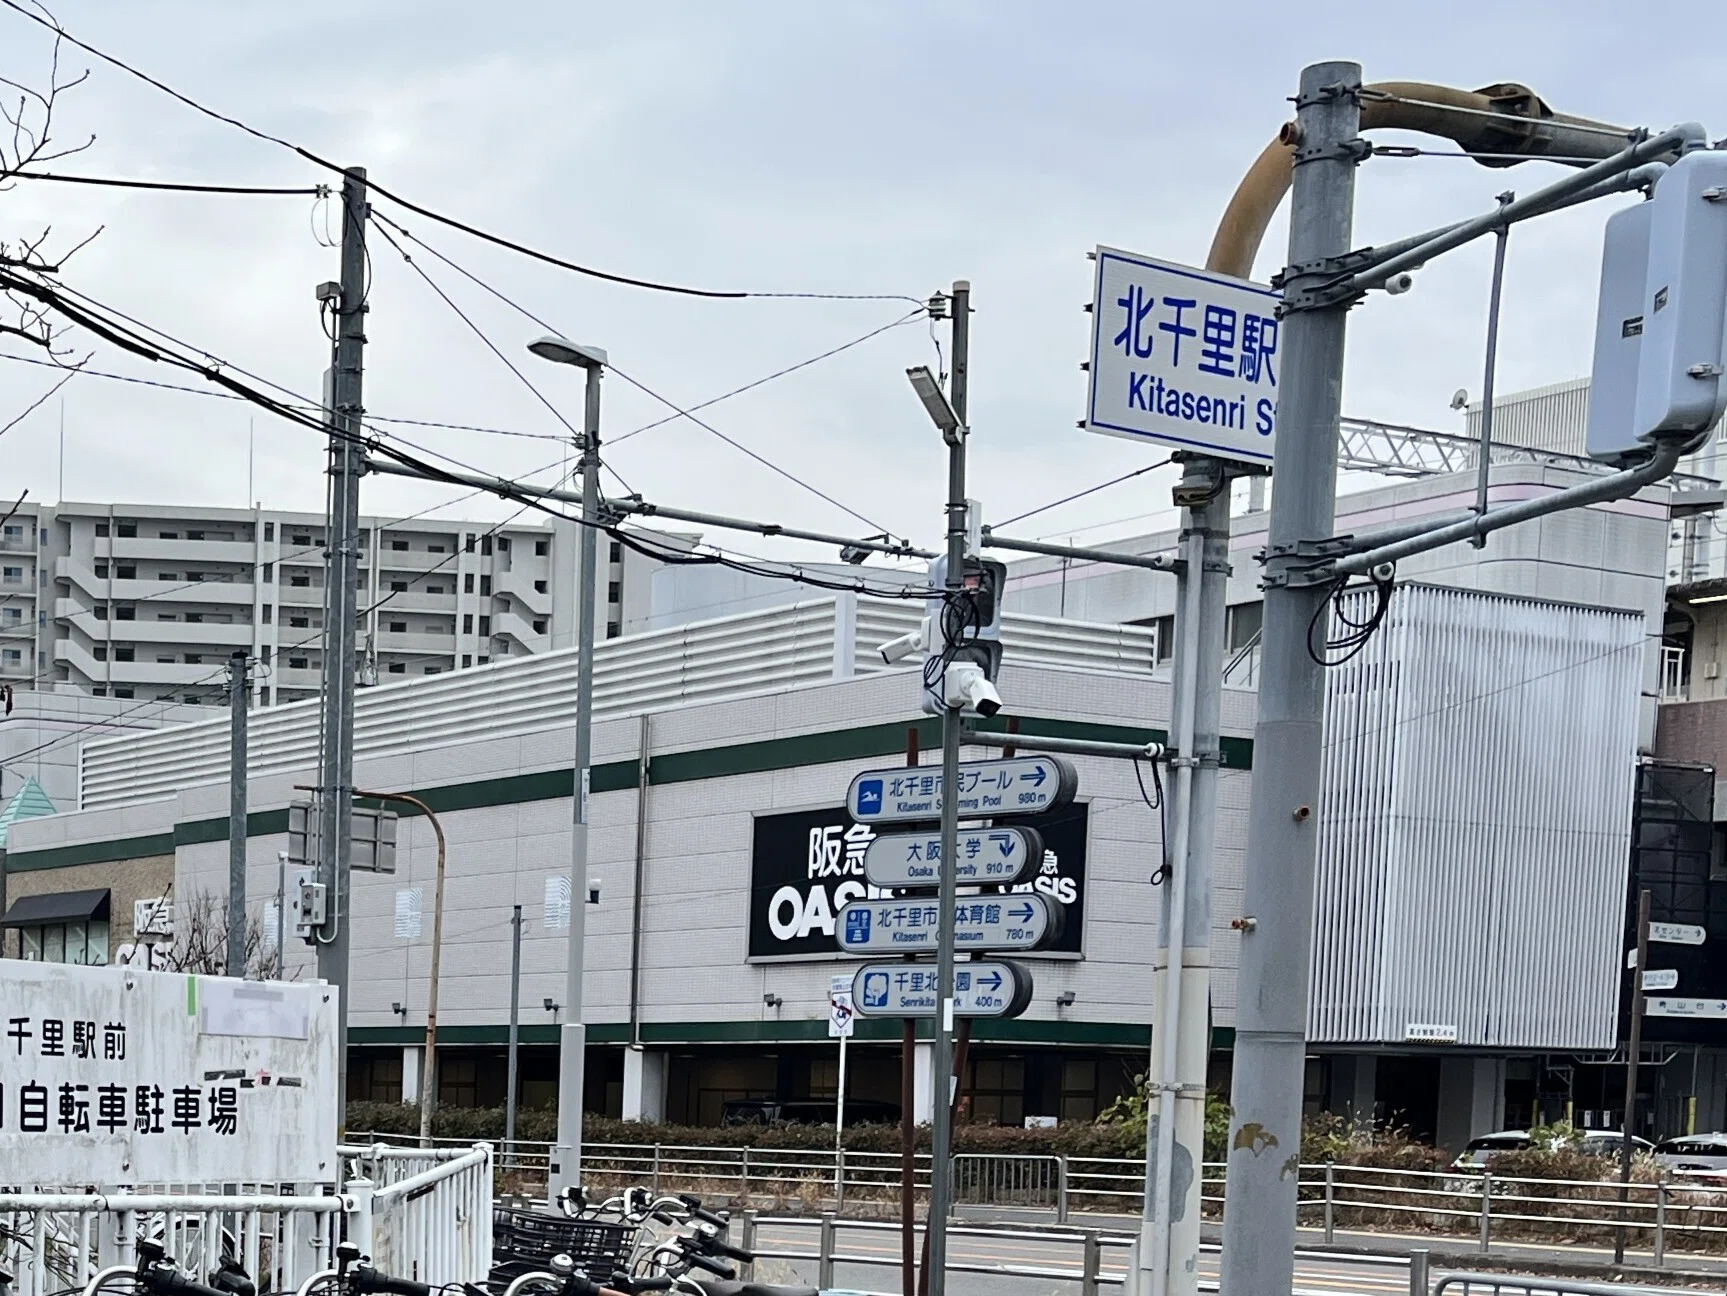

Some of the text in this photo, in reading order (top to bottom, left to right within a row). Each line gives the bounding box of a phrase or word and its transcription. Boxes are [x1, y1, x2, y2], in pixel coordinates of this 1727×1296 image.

[1114, 284, 1278, 387] 北千里駅
[1129, 371, 1277, 436] Kitasenri S
[897, 801, 932, 813] Kitasenri
[982, 795, 1002, 807] Pool
[808, 823, 876, 879] 阪急
[1039, 849, 1059, 875] 急
[908, 866, 933, 877] Osaka
[986, 862, 1003, 874] 910
[1005, 864, 1014, 873] m
[877, 903, 1001, 928] 北千里市体育館
[892, 931, 928, 943] Kitasenri
[894, 971, 971, 992] 千里北園
